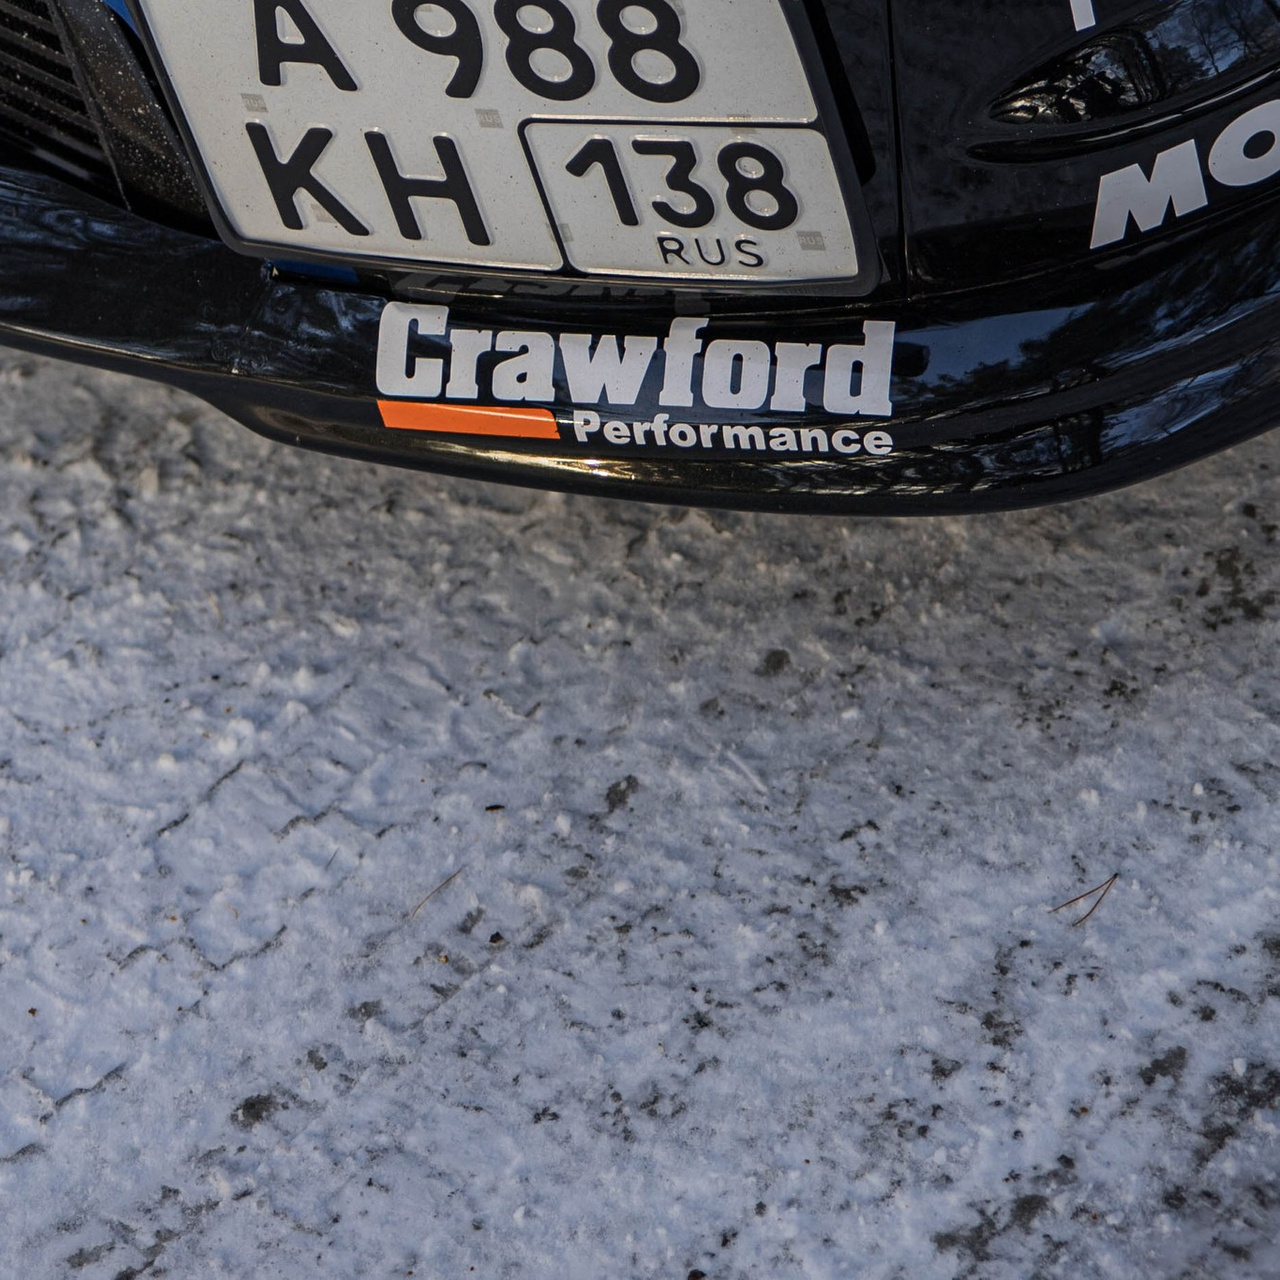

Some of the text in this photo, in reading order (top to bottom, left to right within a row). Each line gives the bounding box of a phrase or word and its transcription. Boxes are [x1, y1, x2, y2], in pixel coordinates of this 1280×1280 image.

[244, 122, 491, 246] KH
[565, 138, 799, 231] 138
[657, 236, 765, 269] RUS
[375, 301, 896, 416] Crawford
[573, 409, 894, 456] Performance
